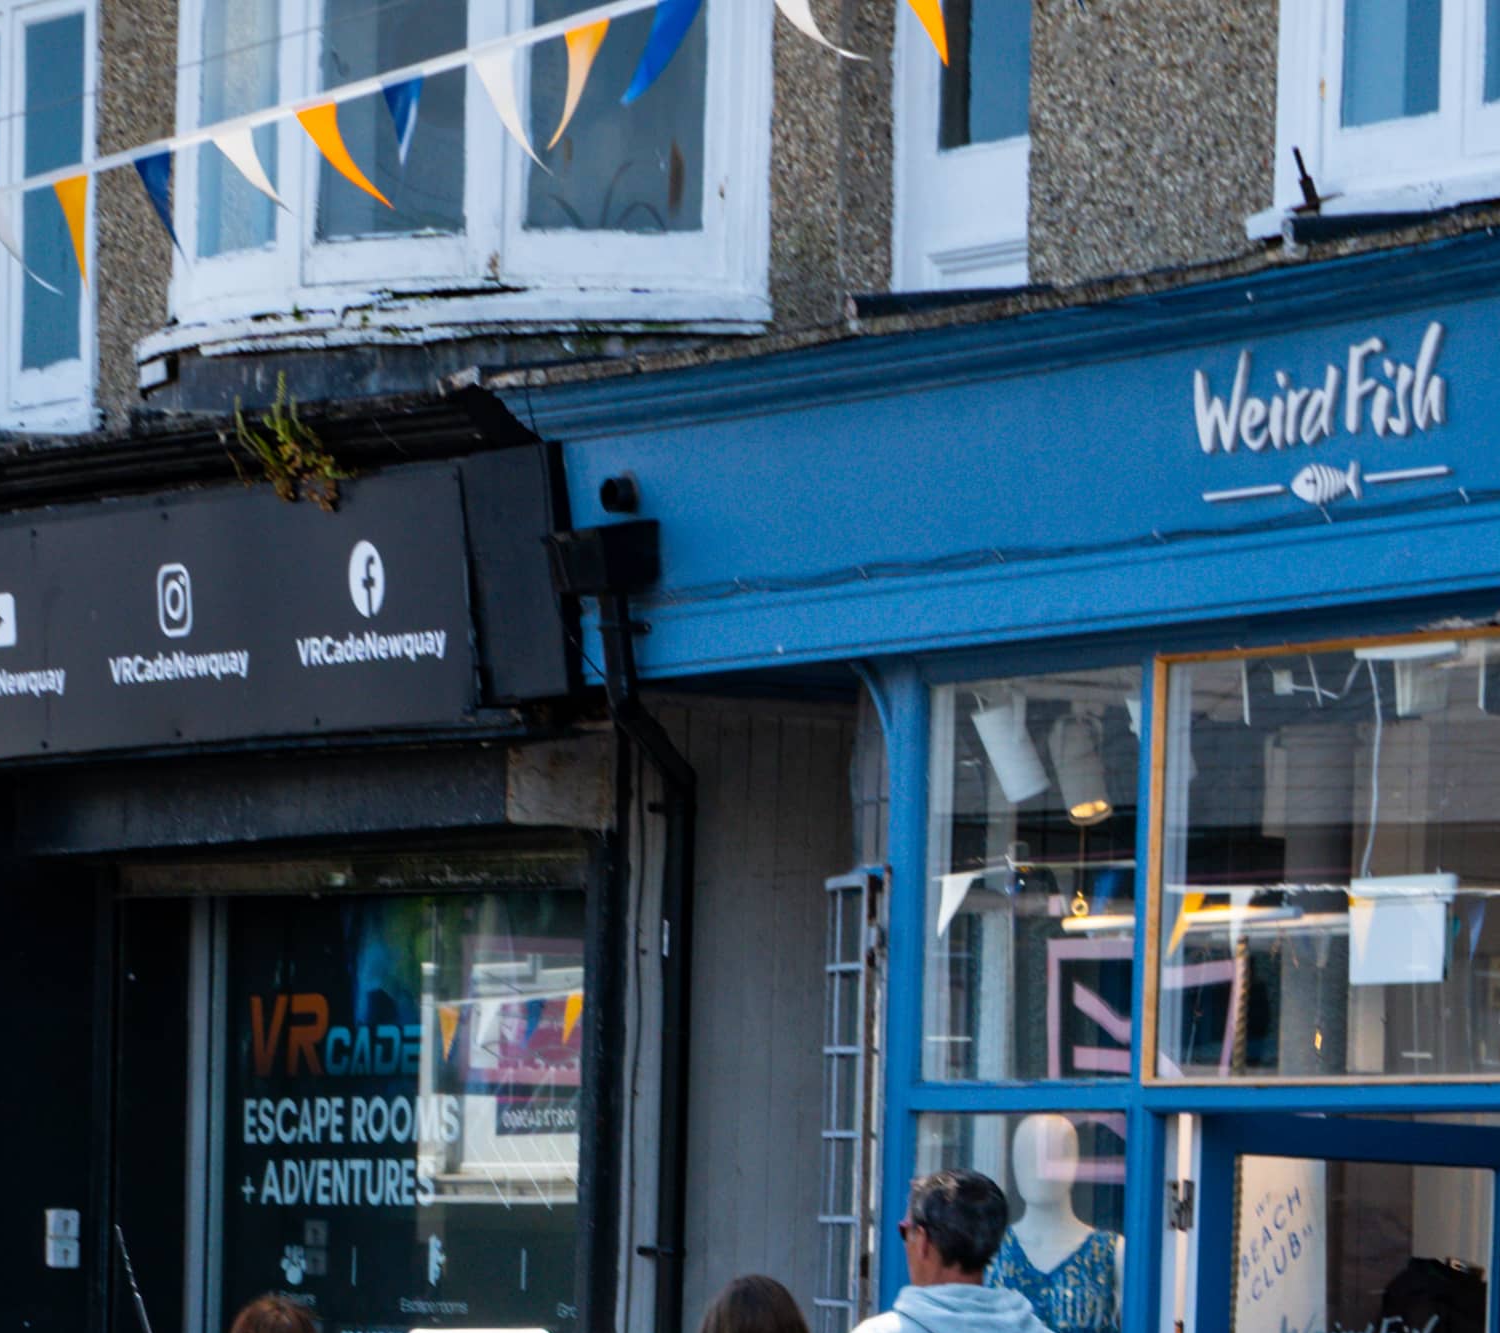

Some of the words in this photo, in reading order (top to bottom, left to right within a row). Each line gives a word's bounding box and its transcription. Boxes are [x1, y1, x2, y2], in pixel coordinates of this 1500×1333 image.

[1193, 348, 1340, 453] Weird
[1345, 321, 1445, 437] Fish
[109, 650, 250, 687] VRCadeNewquay
[297, 629, 448, 668] VRCadeNewquay
[243, 1096, 345, 1146] ESCAPE
[350, 1095, 462, 1146] ROOMS
[261, 1156, 436, 1208] ADVENTURES
[1240, 1186, 1302, 1279] BEACH
